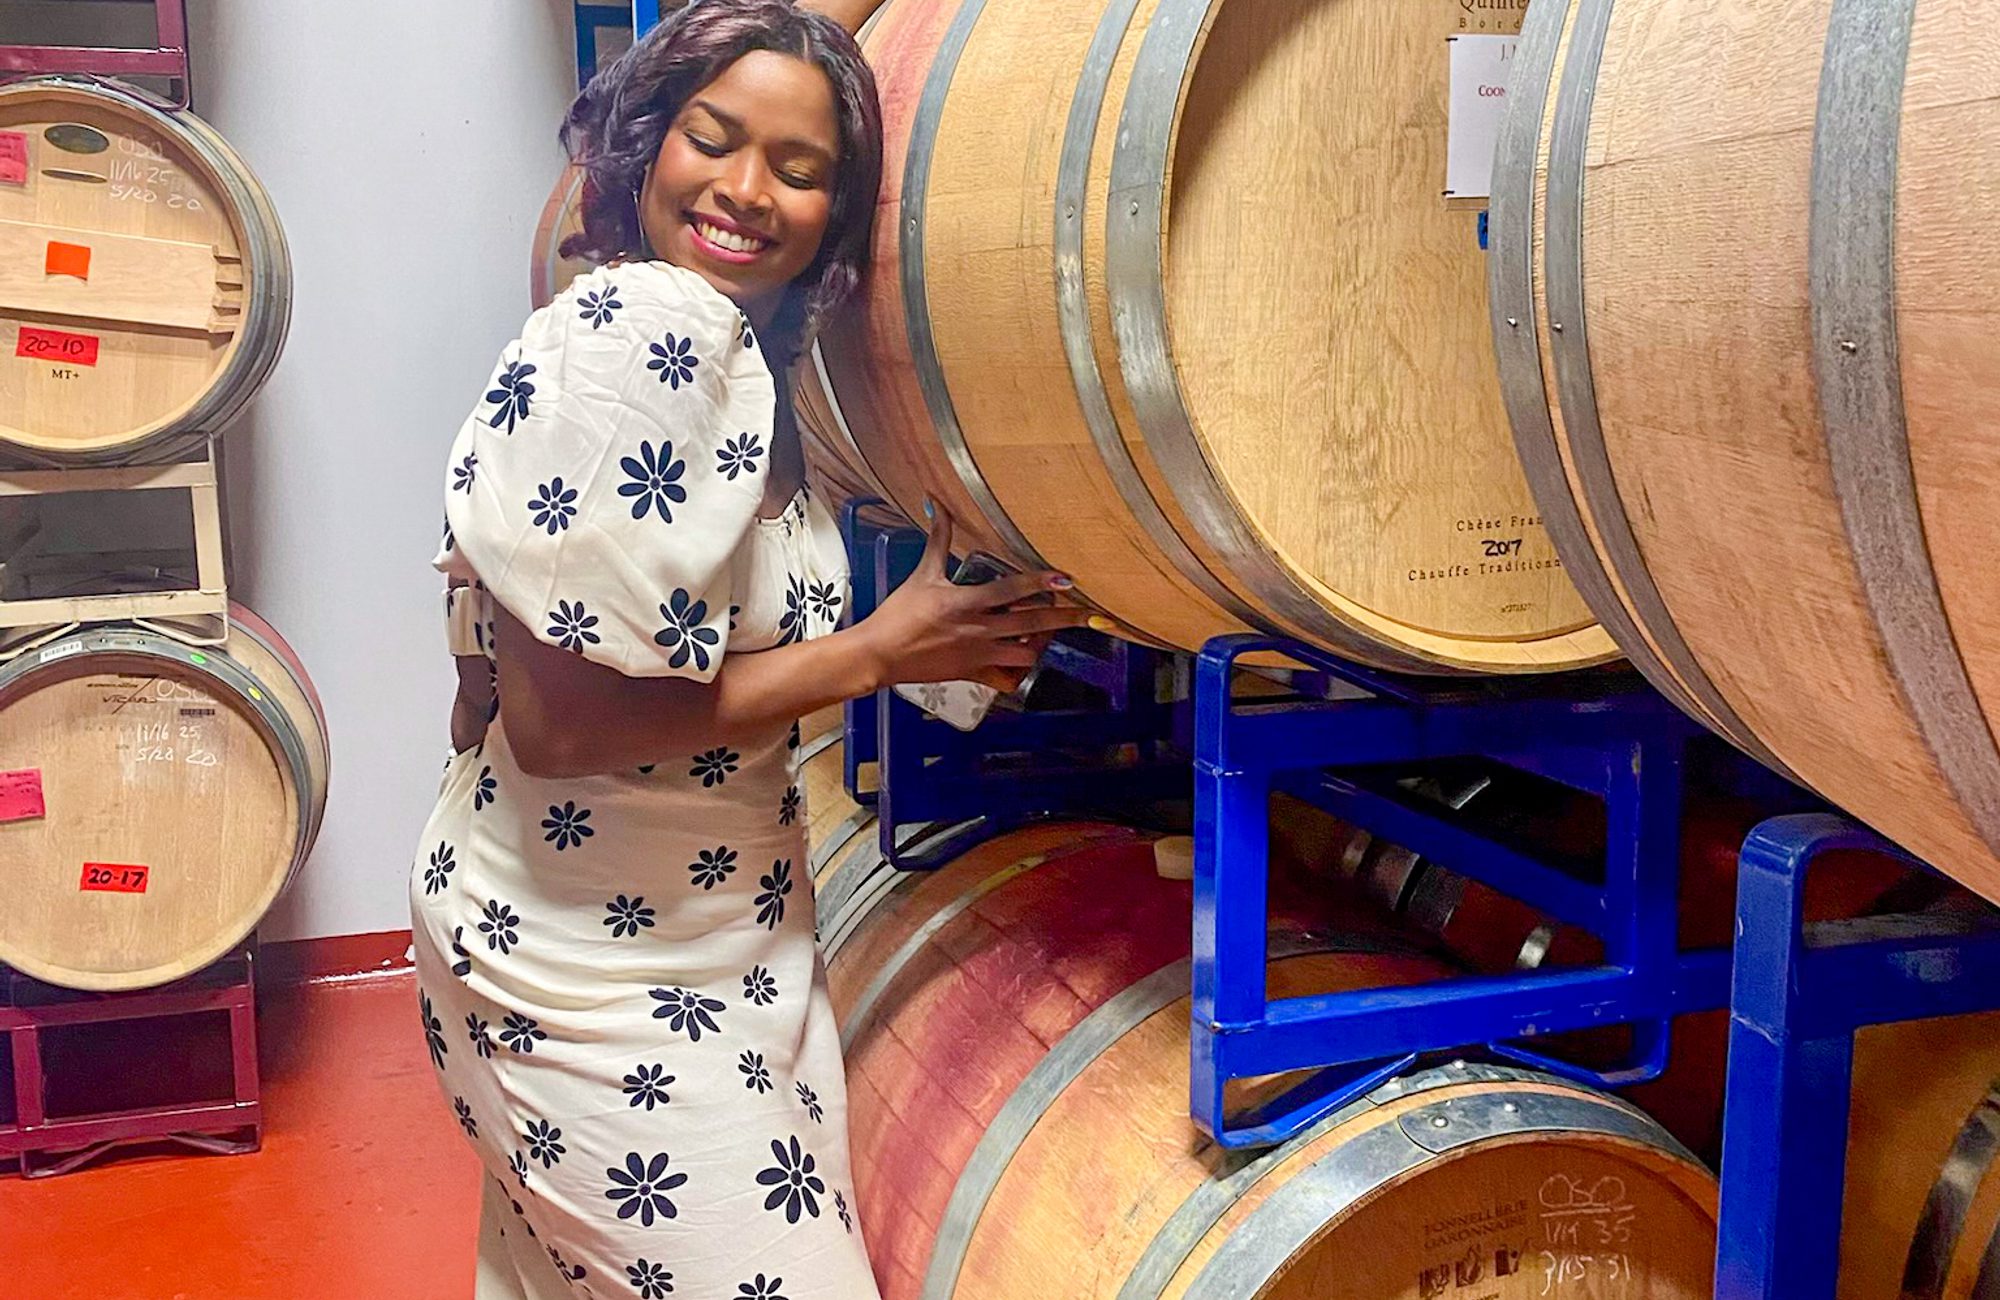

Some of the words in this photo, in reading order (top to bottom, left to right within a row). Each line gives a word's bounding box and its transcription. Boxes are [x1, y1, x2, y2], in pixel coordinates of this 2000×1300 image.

[25, 336, 84, 354] 20-10
[1481, 538, 1523, 556] 2017
[1408, 565, 1469, 581] Chauffe
[87, 868, 145, 888] 20-17
